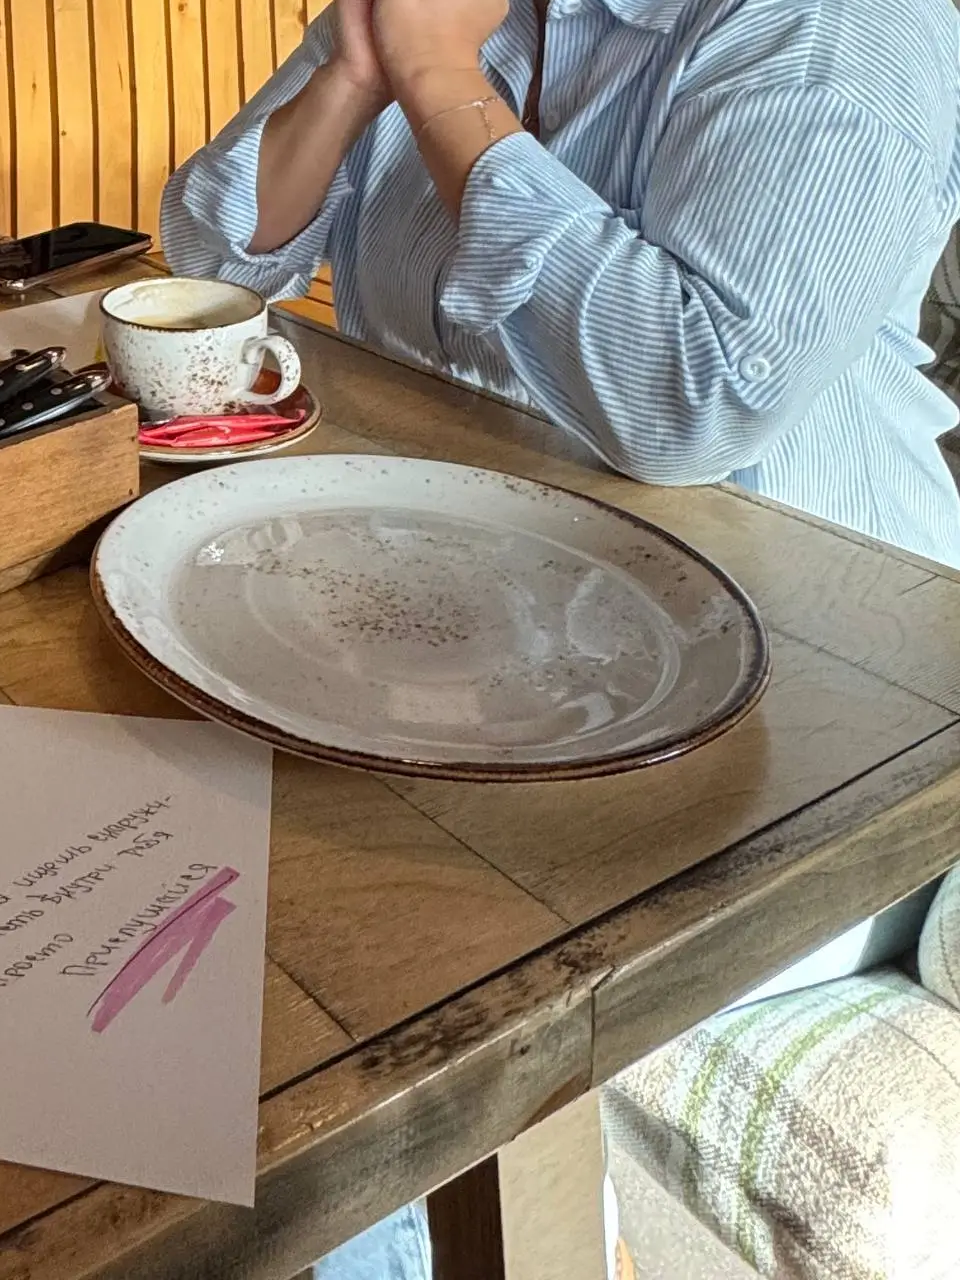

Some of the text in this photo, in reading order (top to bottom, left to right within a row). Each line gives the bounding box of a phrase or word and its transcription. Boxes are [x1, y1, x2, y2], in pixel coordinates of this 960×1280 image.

[12, 844, 92, 888] ищешь
[117, 831, 174, 858] тебя
[59, 863, 219, 976] Прислушайся
